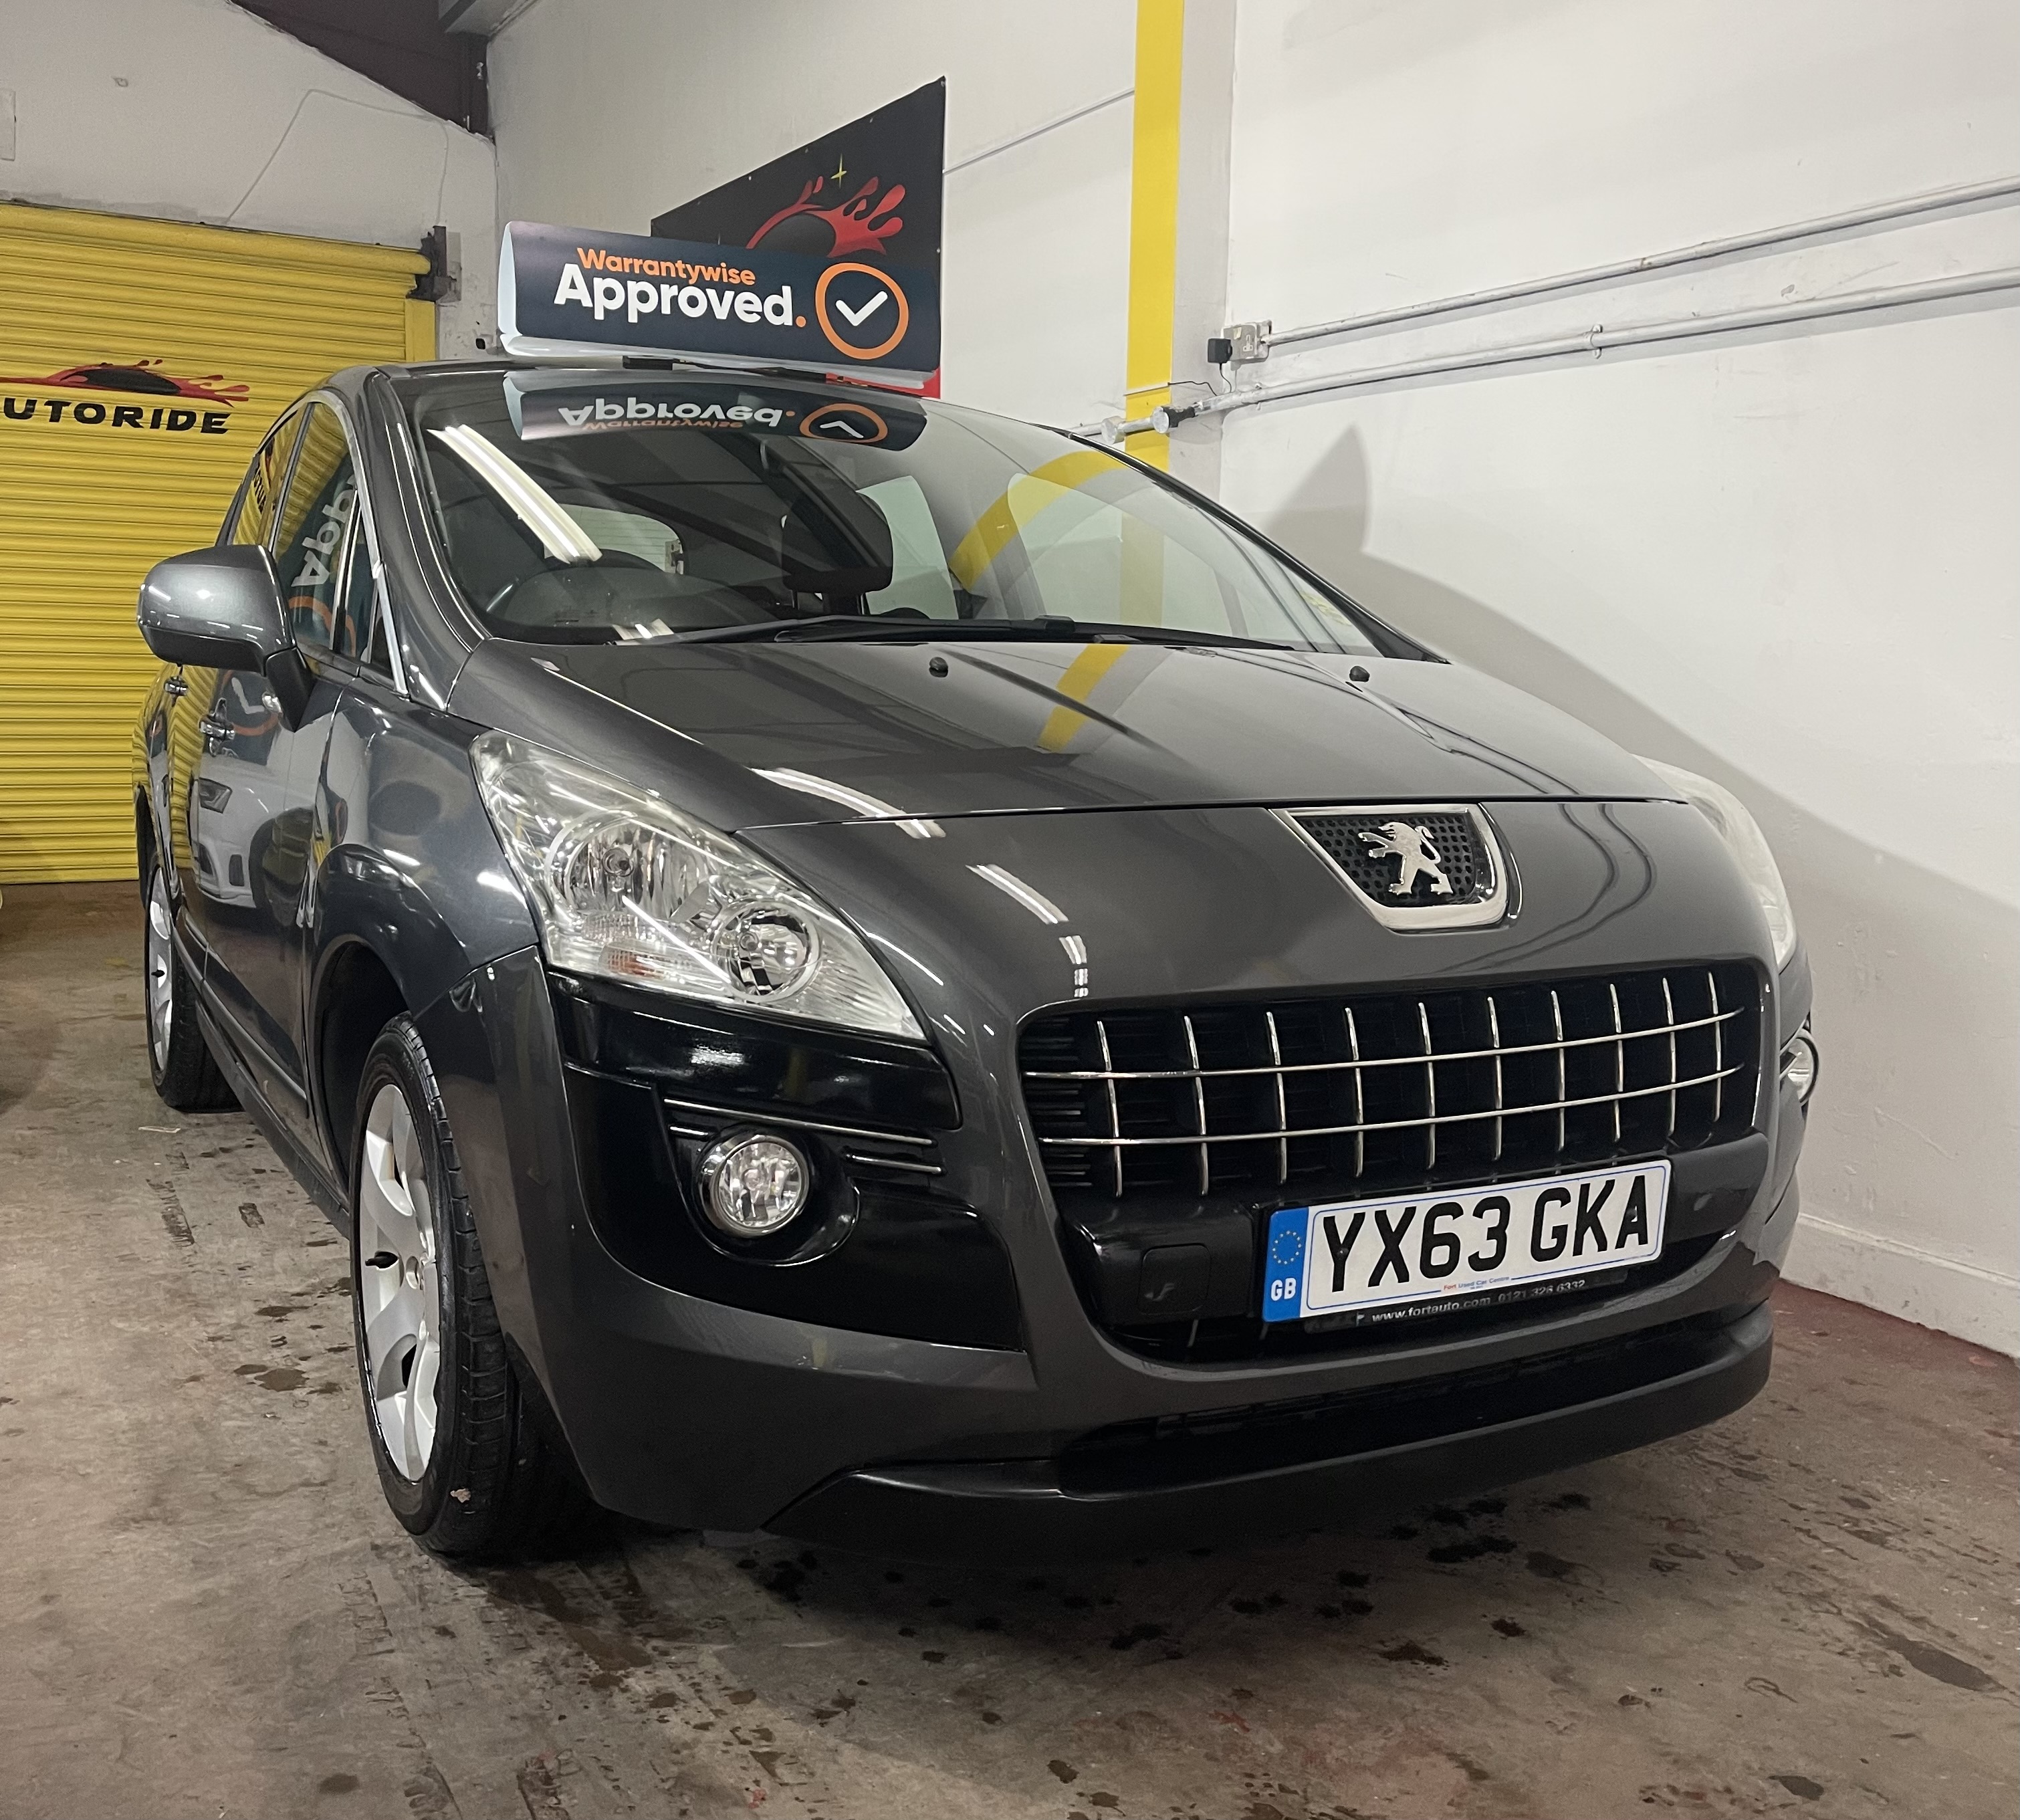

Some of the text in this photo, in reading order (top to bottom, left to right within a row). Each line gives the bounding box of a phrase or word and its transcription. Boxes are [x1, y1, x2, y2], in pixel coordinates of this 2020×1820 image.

[577, 247, 756, 285] Warrantywise
[554, 263, 806, 327] Approved.
[3, 397, 231, 434] UTORIDE
[1323, 1175, 1649, 1292] YX63 GKA
[1270, 1277, 1297, 1301] GB
[1371, 1296, 1491, 1322] www.fortauto.com
[1498, 1289, 1527, 1303] 0121
